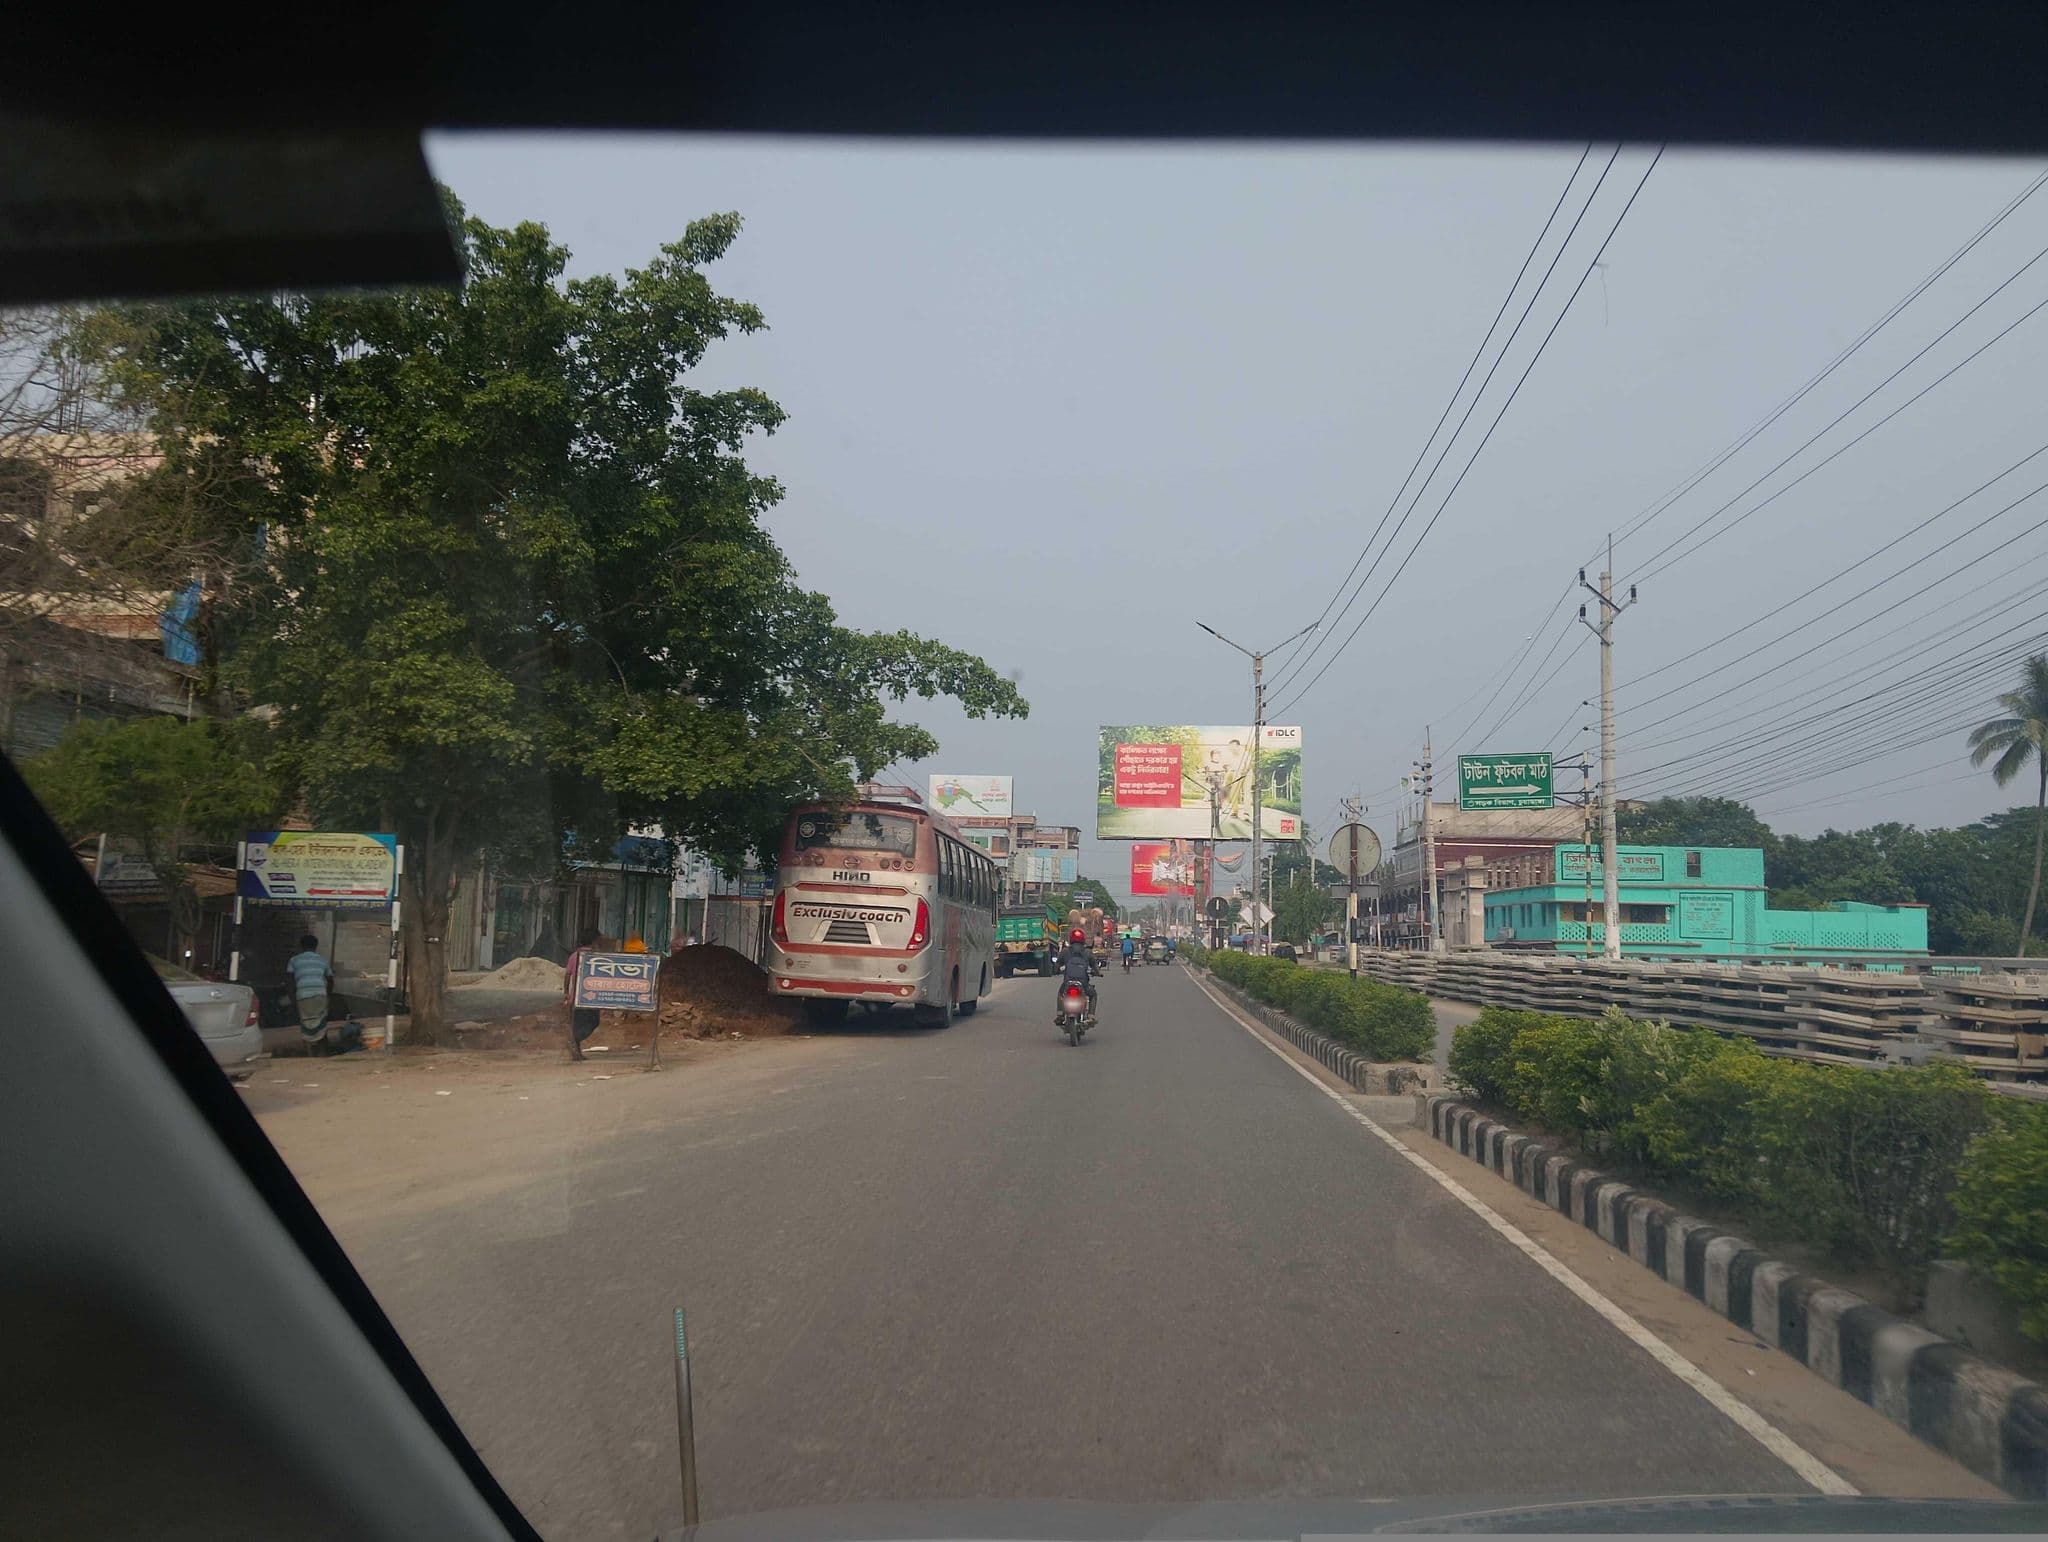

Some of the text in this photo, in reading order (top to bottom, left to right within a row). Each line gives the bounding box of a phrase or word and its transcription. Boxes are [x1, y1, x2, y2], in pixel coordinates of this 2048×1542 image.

[1275, 729, 1295, 737] IDLC
[1145, 756, 1168, 764] দরকার
[1119, 765, 1137, 775] একটু
[1462, 756, 1549, 785] টাউন ফুটবল মাঠ
[832, 871, 871, 882] HINO
[859, 911, 904, 923] coach
[585, 957, 653, 979] বিভা
